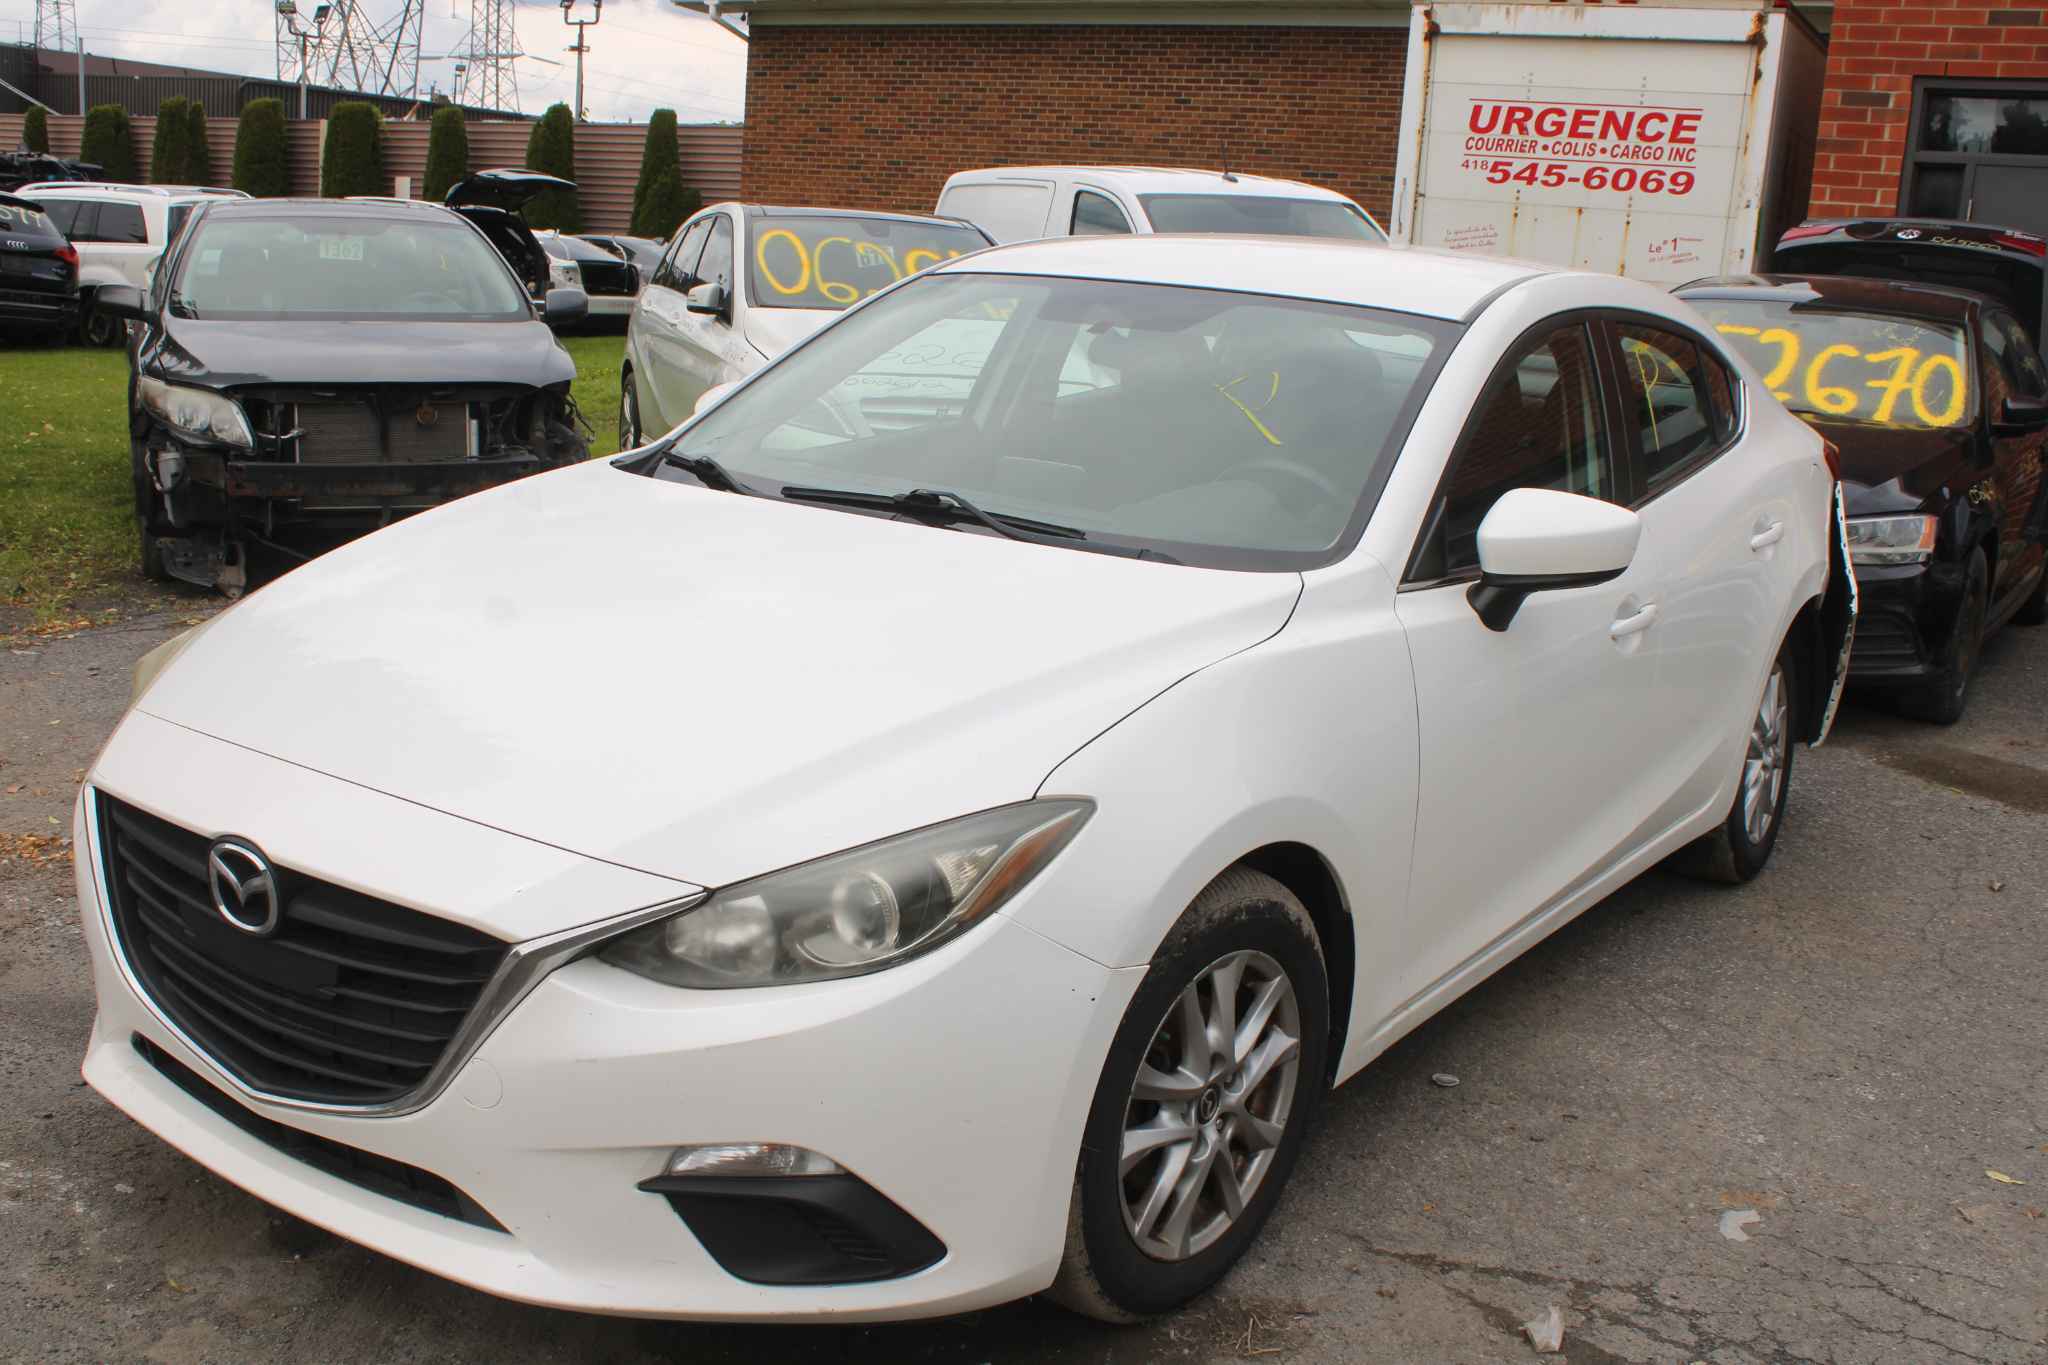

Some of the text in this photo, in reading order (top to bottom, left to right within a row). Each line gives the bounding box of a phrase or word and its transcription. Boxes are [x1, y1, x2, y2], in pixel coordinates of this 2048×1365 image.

[1469, 105, 1702, 145] URGENCE
[1465, 136, 1697, 163] COURRIER COLIS CARGO INC
[1461, 159, 1695, 195] 418 545-6069
[1715, 323, 1966, 428] 2670
